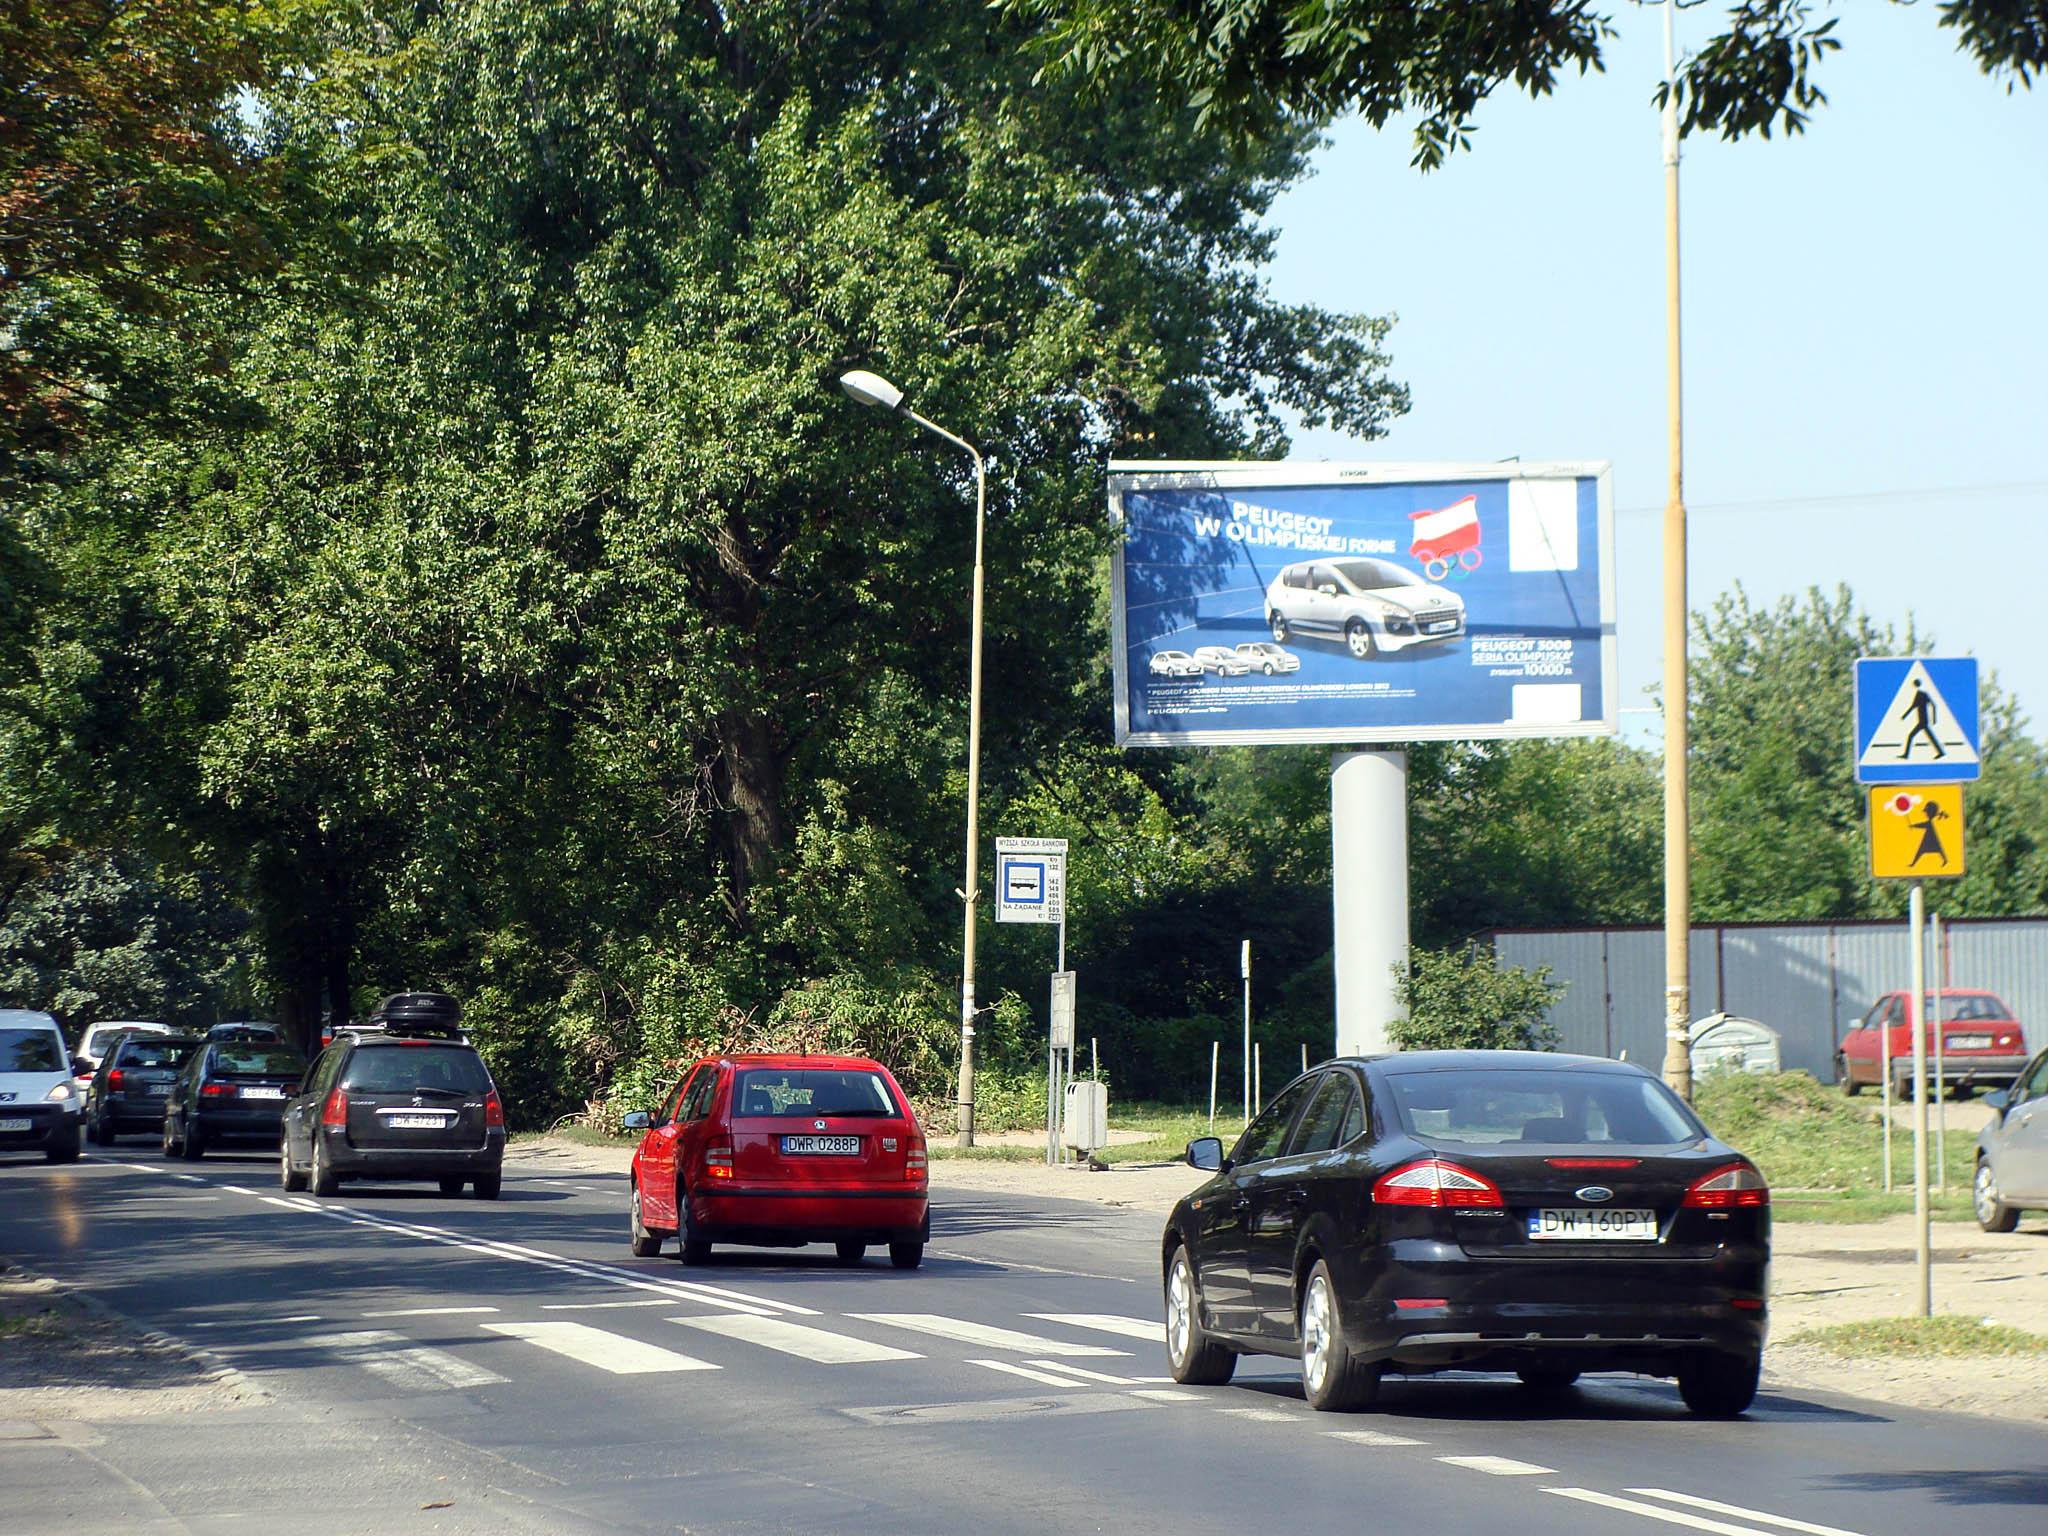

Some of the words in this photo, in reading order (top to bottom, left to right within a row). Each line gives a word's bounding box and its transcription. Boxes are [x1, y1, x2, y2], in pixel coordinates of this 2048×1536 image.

[1194, 516, 1221, 538] W
[1232, 501, 1334, 536] PEUGEOT
[1471, 640, 1536, 652] PEUGEOT
[788, 1136, 814, 1151] DWR
[817, 1136, 858, 1151] 0288P
[1544, 1210, 1576, 1232] DW
[1586, 1211, 1652, 1232] 160PY
